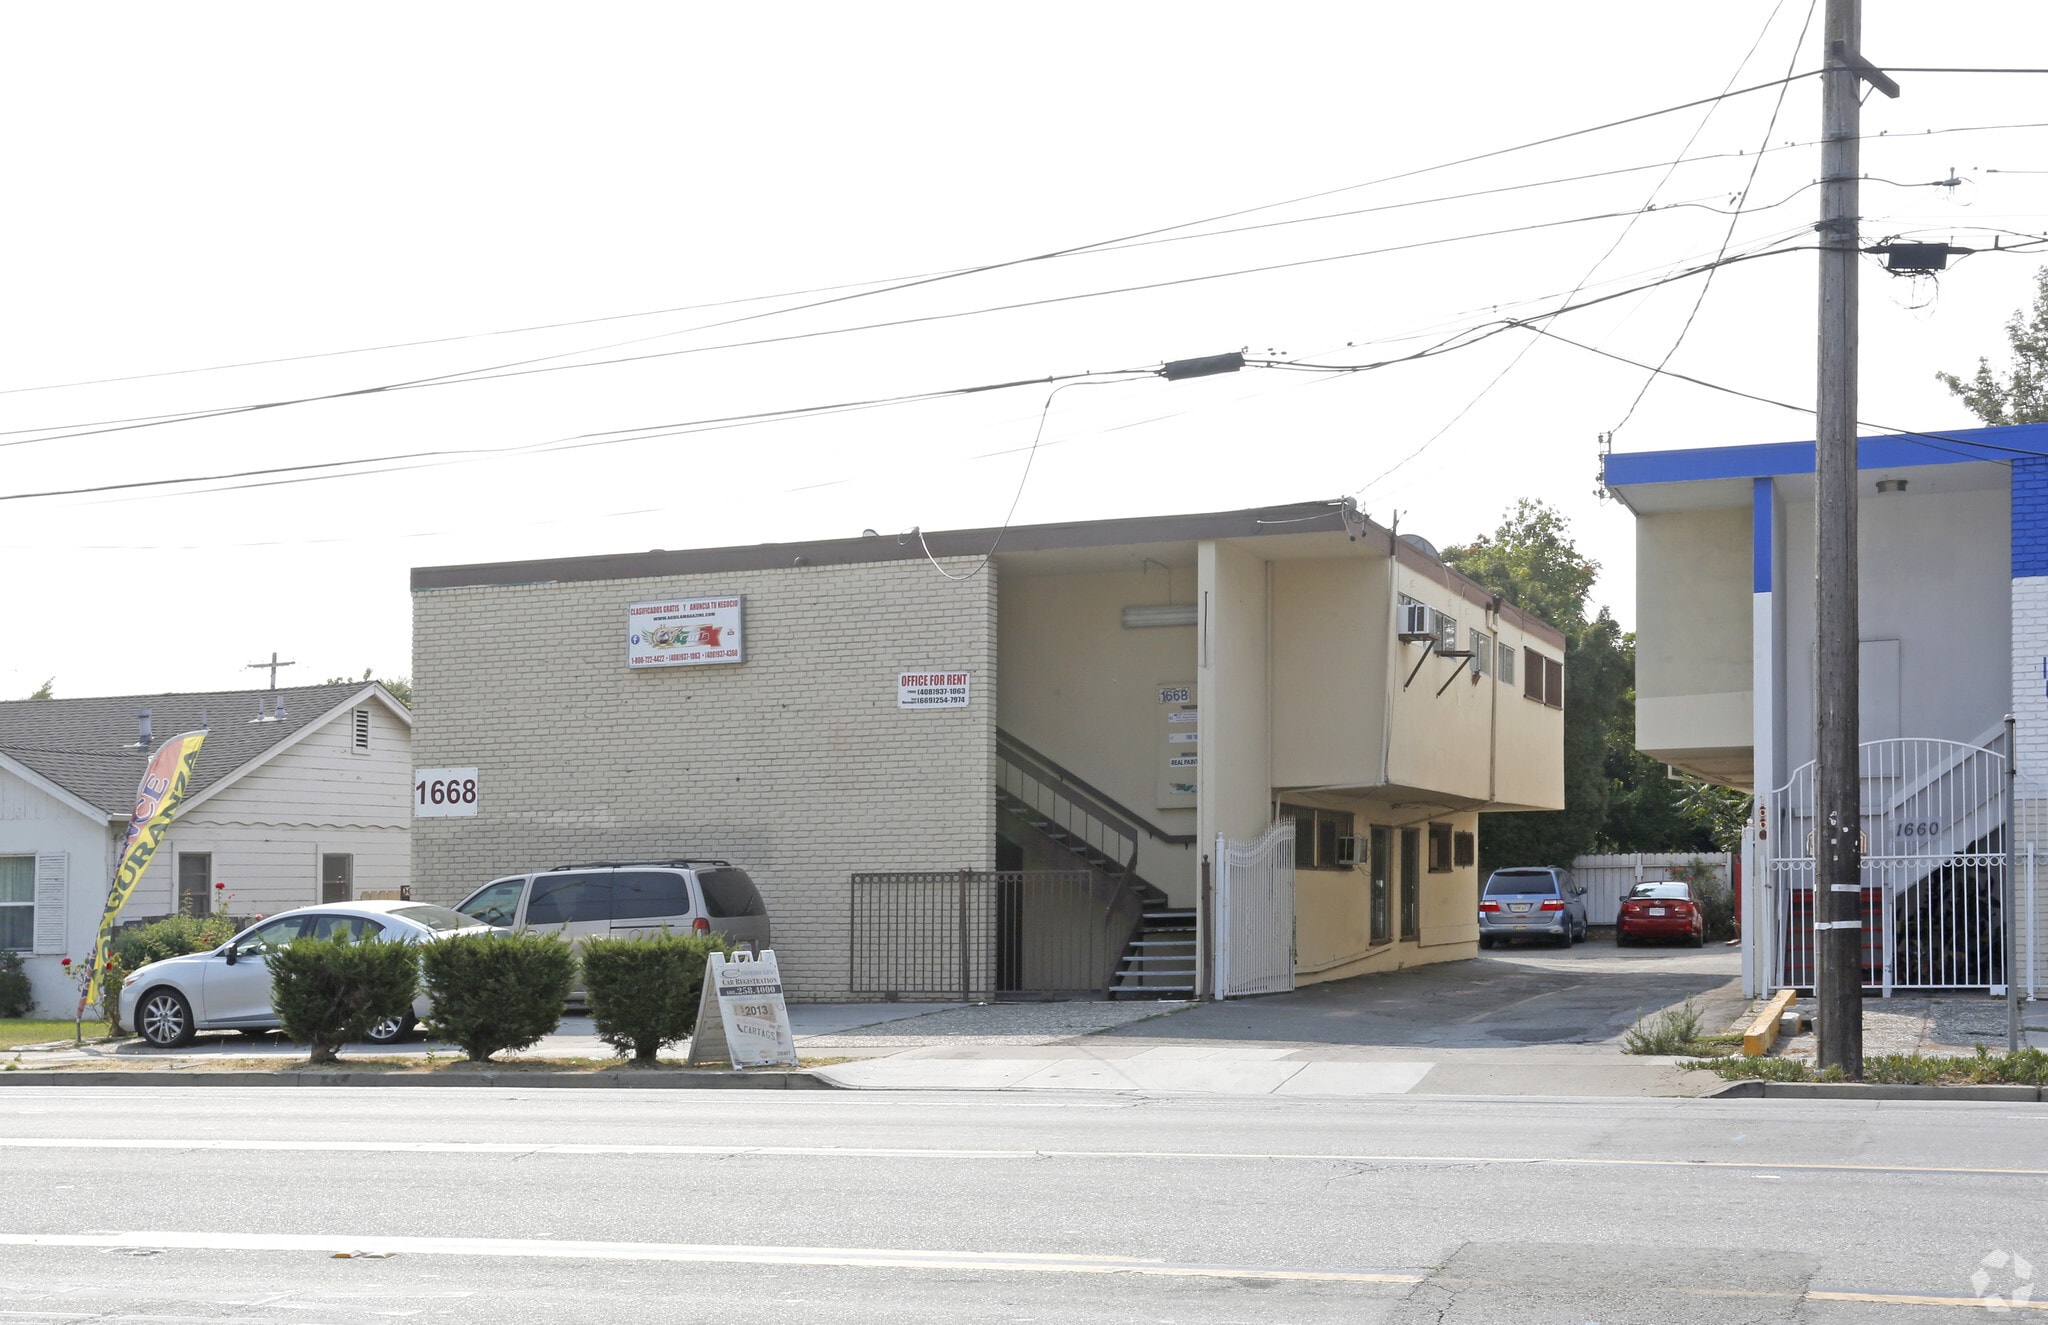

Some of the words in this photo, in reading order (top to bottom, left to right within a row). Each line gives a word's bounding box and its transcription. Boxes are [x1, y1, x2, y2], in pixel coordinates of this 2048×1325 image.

[631, 606, 662, 615] CLASIFICADOS
[690, 602, 710, 610] ANUNCIA
[717, 600, 738, 608] NEGOCIO
[901, 675, 928, 686] OFFICE
[929, 674, 945, 686] FOR
[947, 674, 967, 685] RENT
[1161, 690, 1188, 702] 1668
[416, 779, 476, 804] 1668
[1896, 822, 1939, 836] 1660
[735, 977, 778, 985] REGISTRATION
[745, 1006, 768, 1015] 2013
